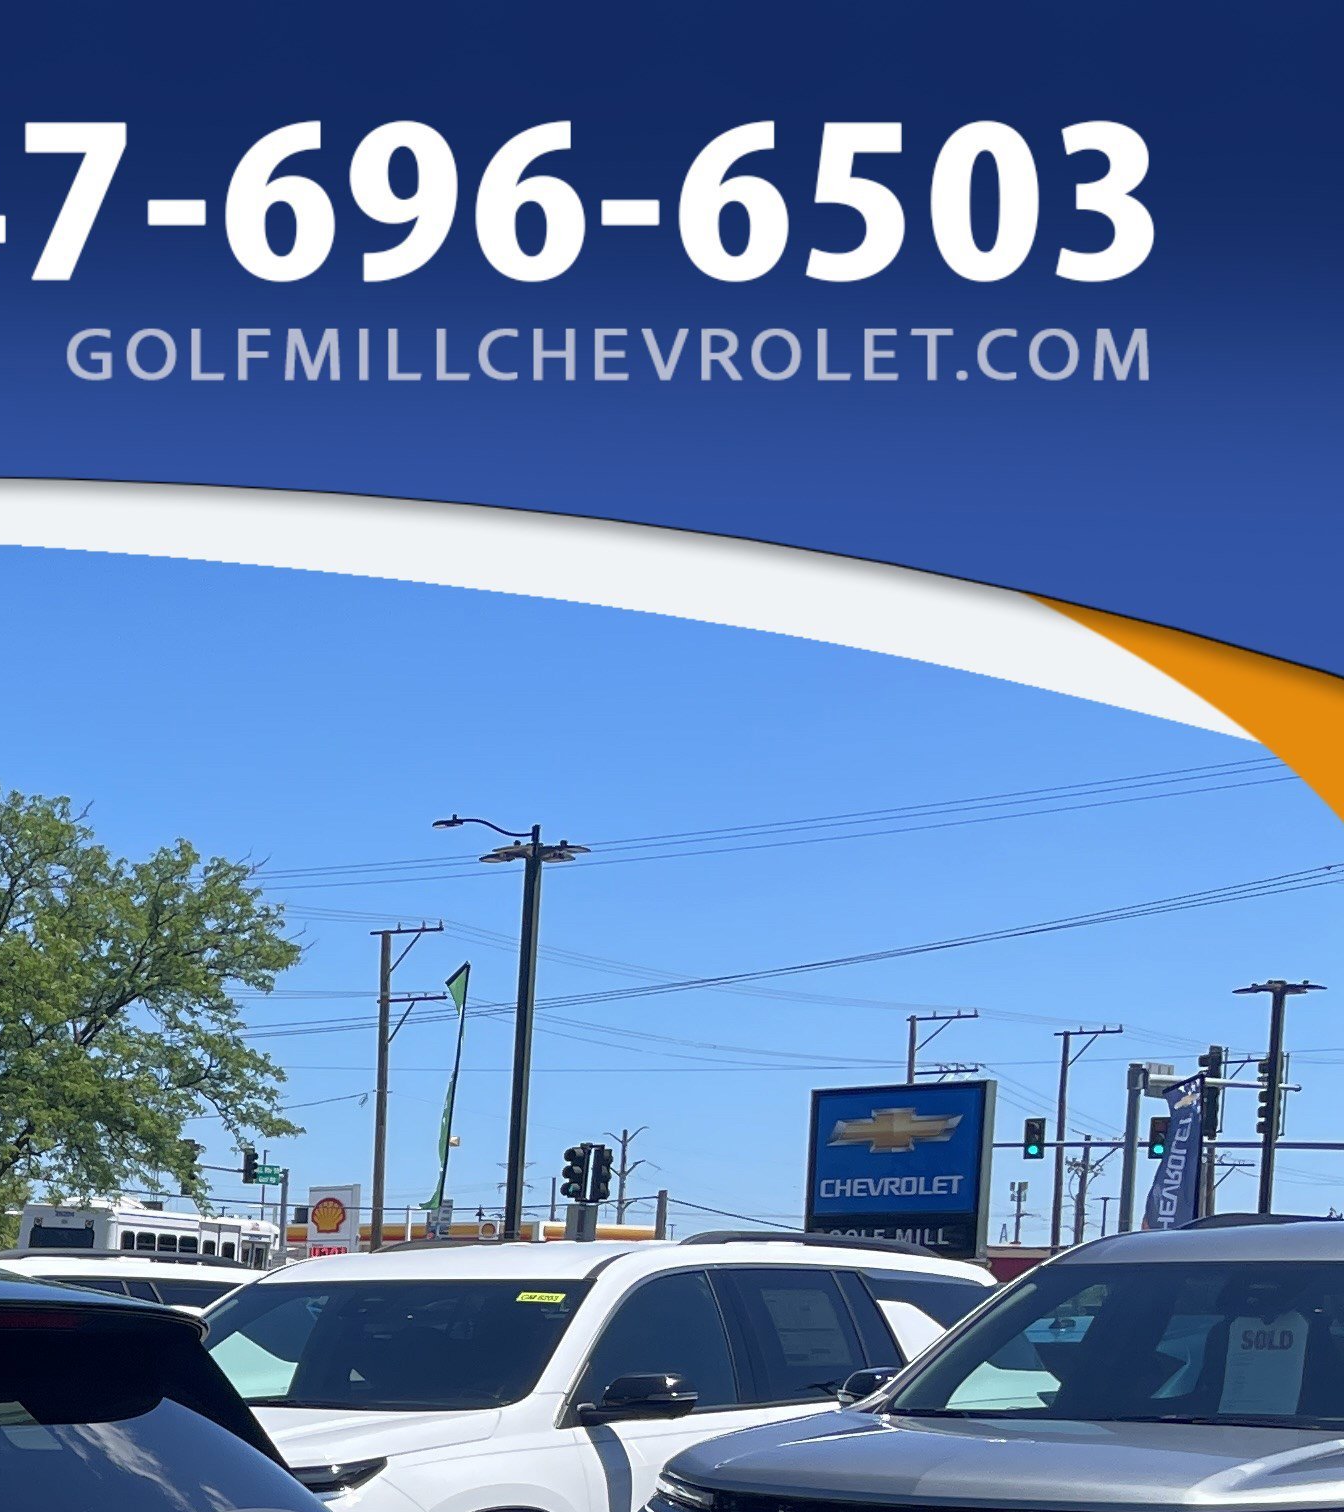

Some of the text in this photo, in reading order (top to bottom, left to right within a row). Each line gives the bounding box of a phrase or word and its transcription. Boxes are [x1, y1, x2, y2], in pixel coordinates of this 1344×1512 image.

[1157, 1113, 1194, 1231] HEVROLET
[819, 1174, 965, 1199] CHEVROLET
[895, 1228, 950, 1246] MILL
[1240, 1329, 1294, 1351] SOLD
